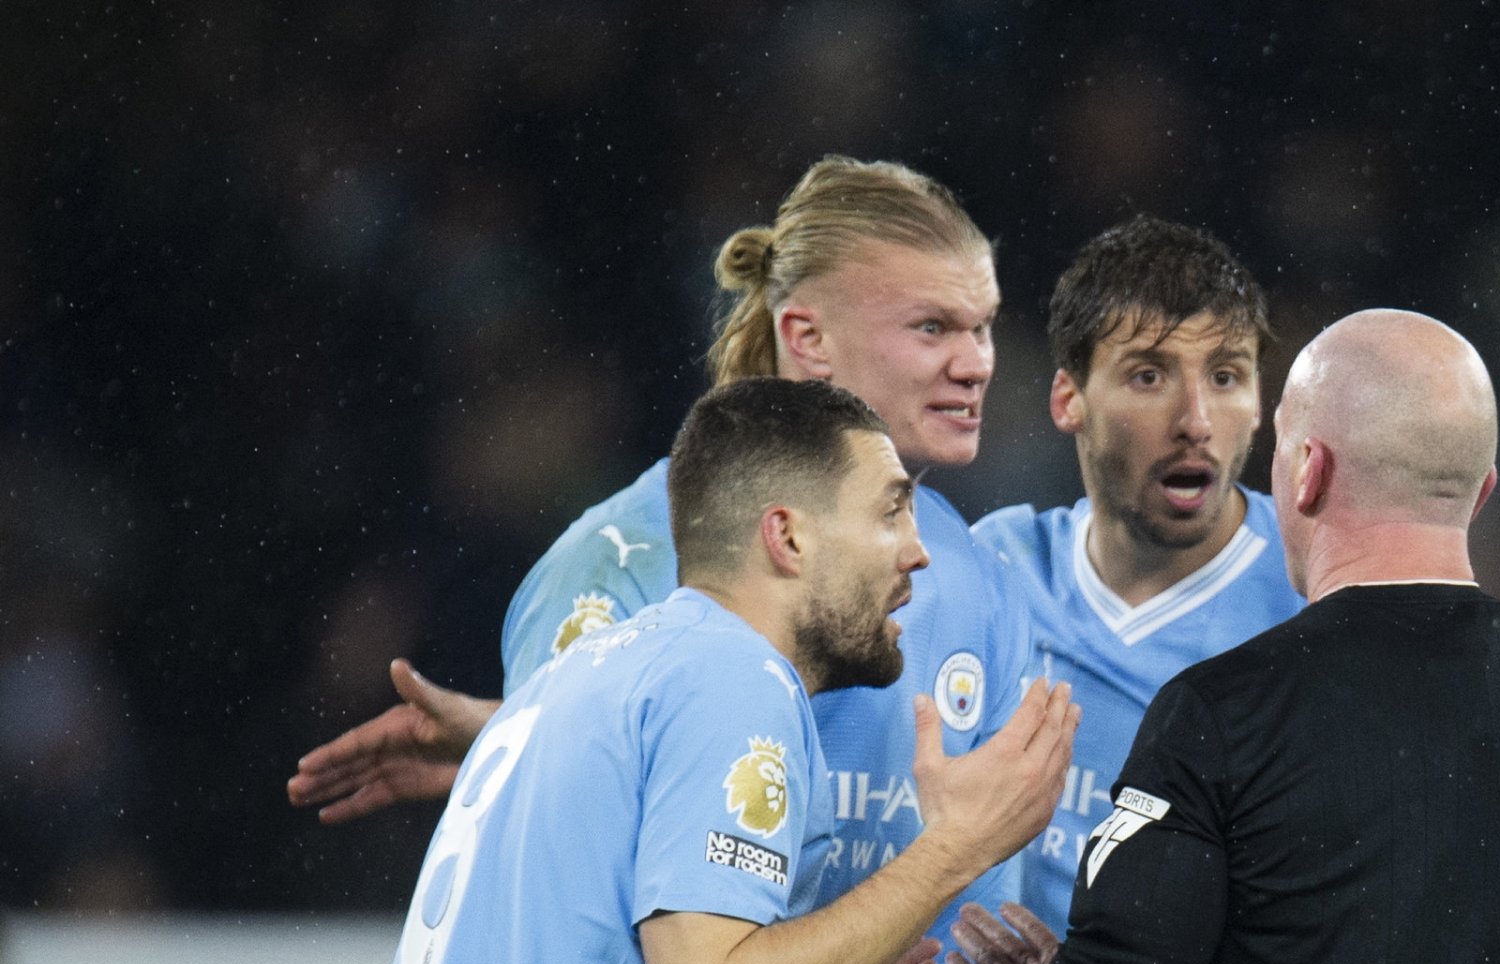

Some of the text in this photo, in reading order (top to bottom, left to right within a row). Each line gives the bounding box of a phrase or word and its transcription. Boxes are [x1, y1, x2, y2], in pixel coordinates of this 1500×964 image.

[1120, 790, 1155, 813] PORTS
[705, 847, 735, 865] for
[706, 831, 782, 871] No room
